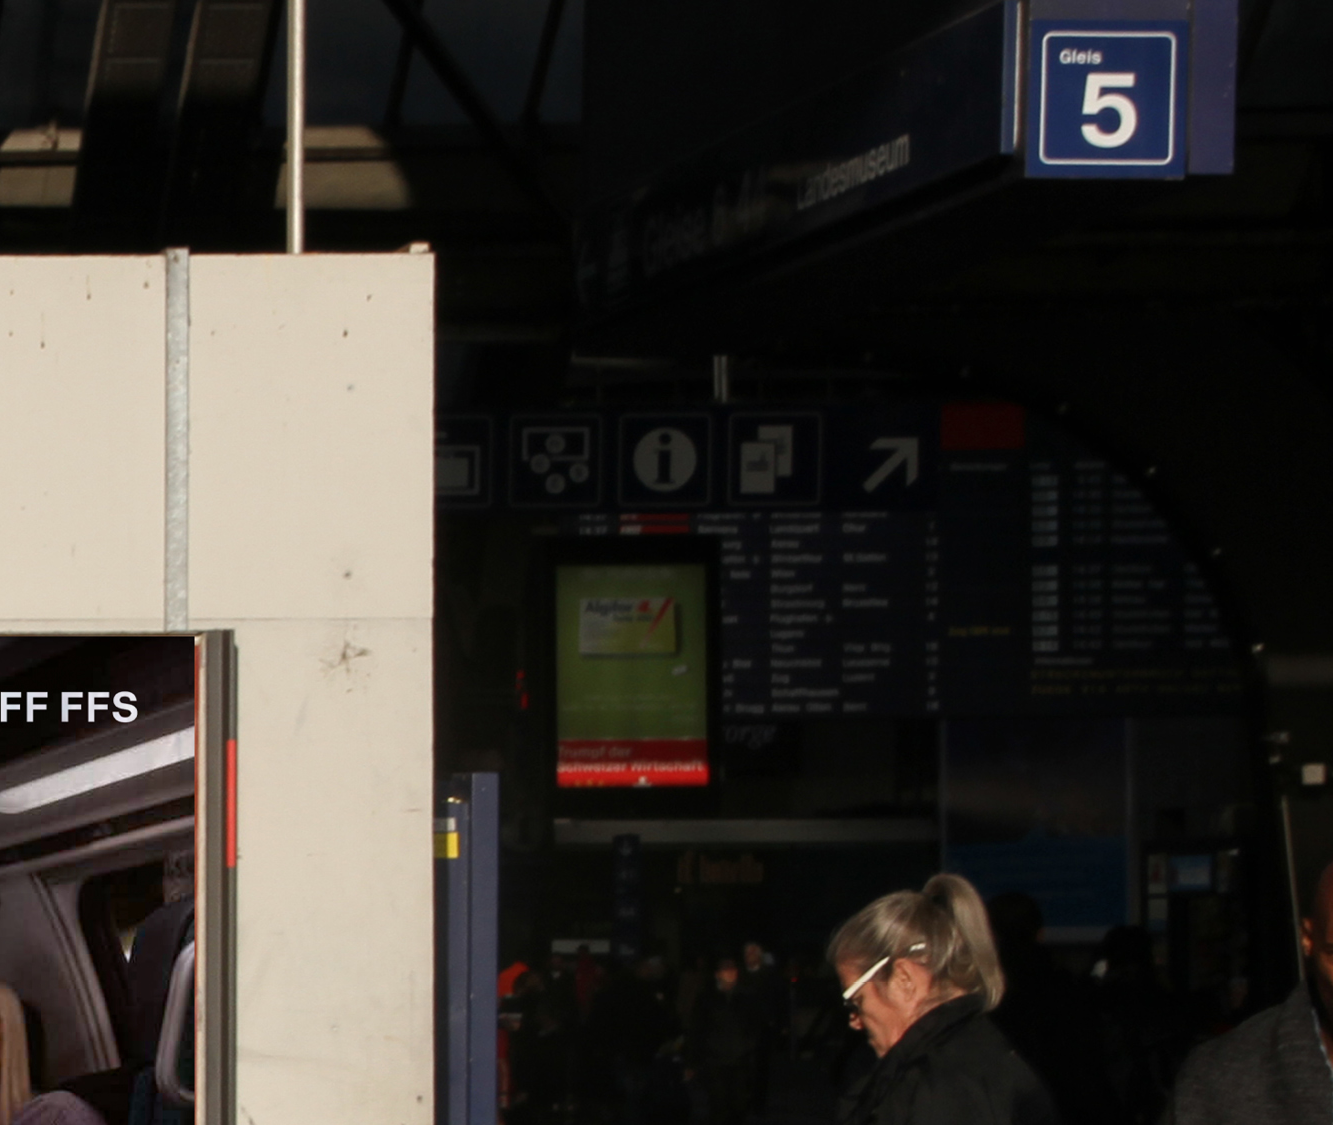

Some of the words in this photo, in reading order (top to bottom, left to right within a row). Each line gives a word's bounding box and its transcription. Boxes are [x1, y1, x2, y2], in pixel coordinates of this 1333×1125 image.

[1059, 48, 1103, 65] Gleis
[1081, 72, 1137, 149] 5
[796, 133, 911, 212] Landesmuseum
[62, 690, 138, 723] FFS
